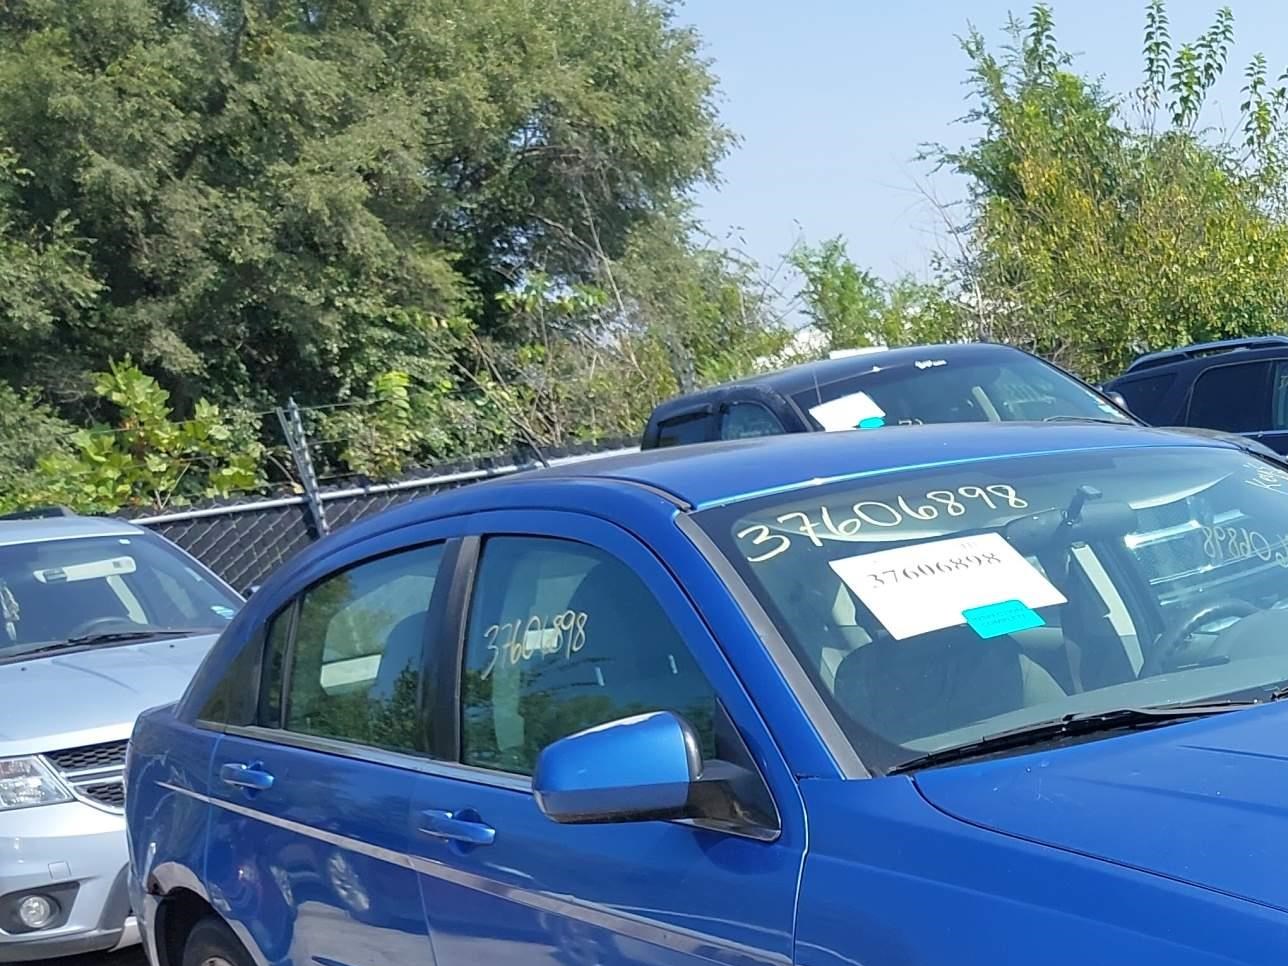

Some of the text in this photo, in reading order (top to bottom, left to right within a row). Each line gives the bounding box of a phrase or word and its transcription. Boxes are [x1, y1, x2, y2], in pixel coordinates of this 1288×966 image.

[737, 484, 1029, 563] 37606898
[867, 552, 1002, 589] 37606898
[480, 609, 589, 681] 37606898
